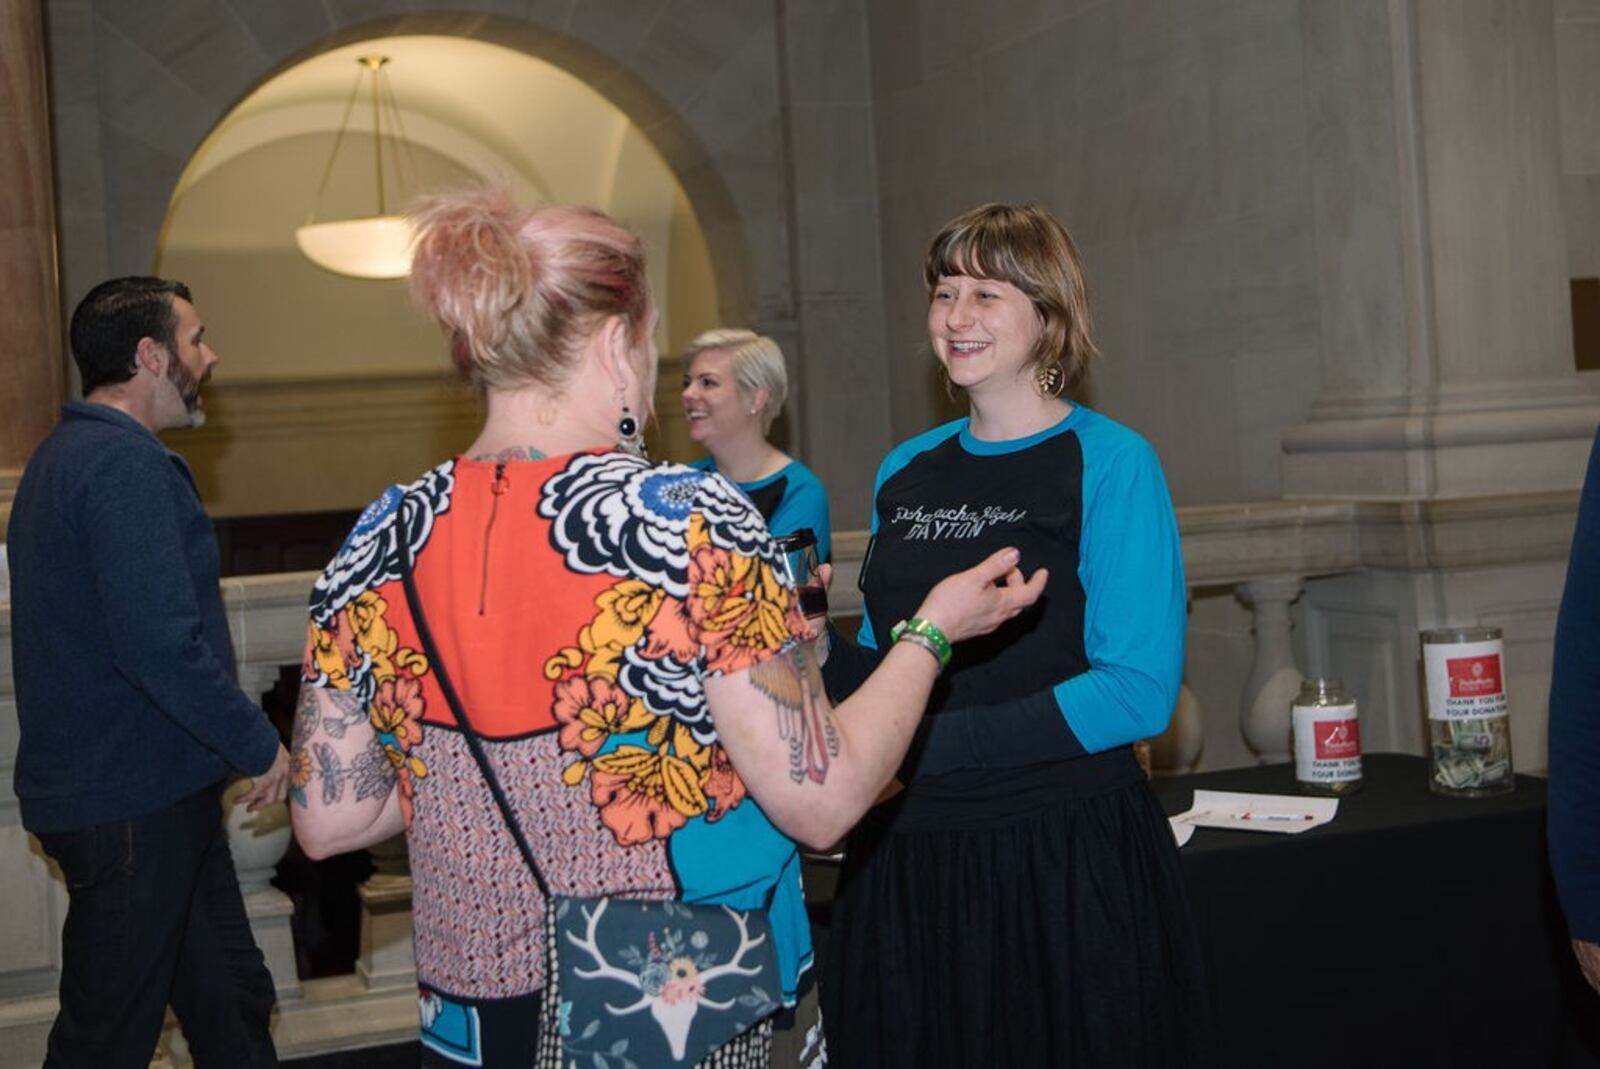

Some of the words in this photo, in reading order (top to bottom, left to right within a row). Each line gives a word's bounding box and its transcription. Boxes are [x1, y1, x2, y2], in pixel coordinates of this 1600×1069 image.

[903, 520, 986, 540] DAYTON
[1446, 698, 1474, 706] THANK
[1446, 708, 1469, 717] YOUR
[1311, 760, 1339, 769] THANK
[1311, 770, 1334, 779] YOUR
